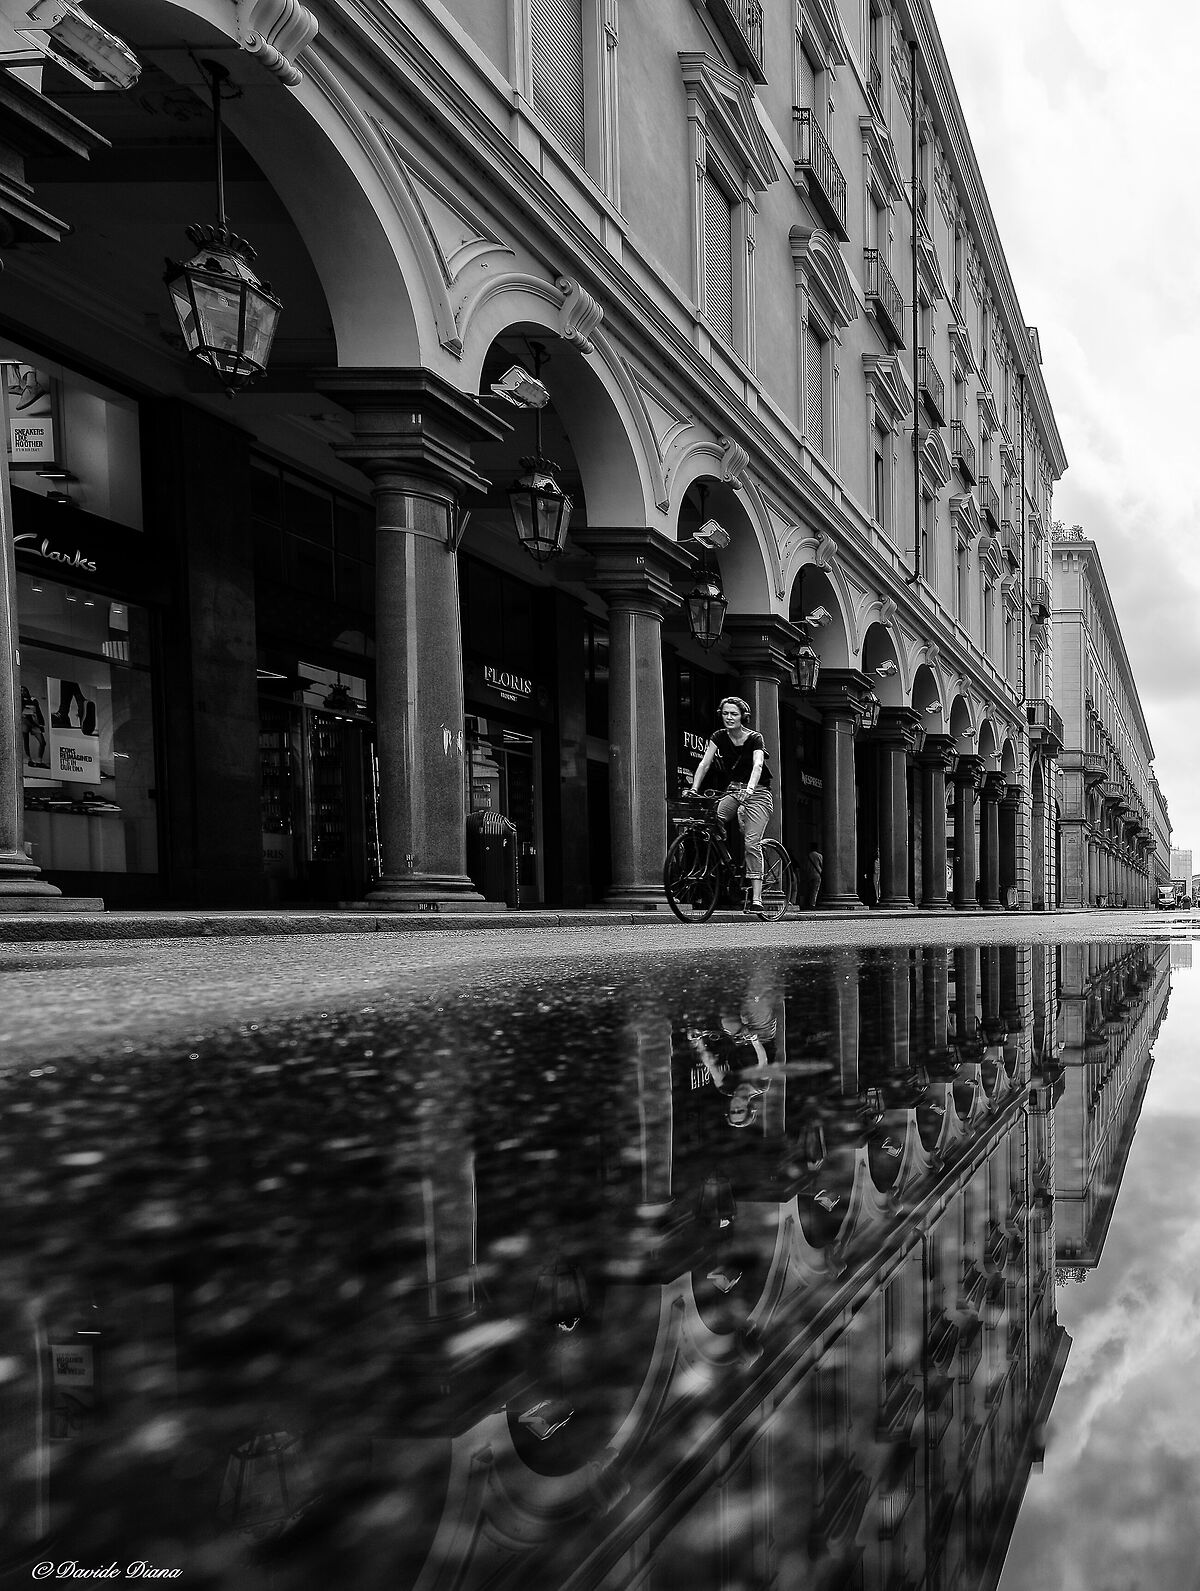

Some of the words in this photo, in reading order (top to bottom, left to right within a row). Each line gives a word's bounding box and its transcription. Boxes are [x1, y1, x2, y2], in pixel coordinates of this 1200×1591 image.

[14, 428, 45, 436] SNEAKERS
[13, 533, 97, 572] Clarks
[483, 664, 532, 694] FLORIS
